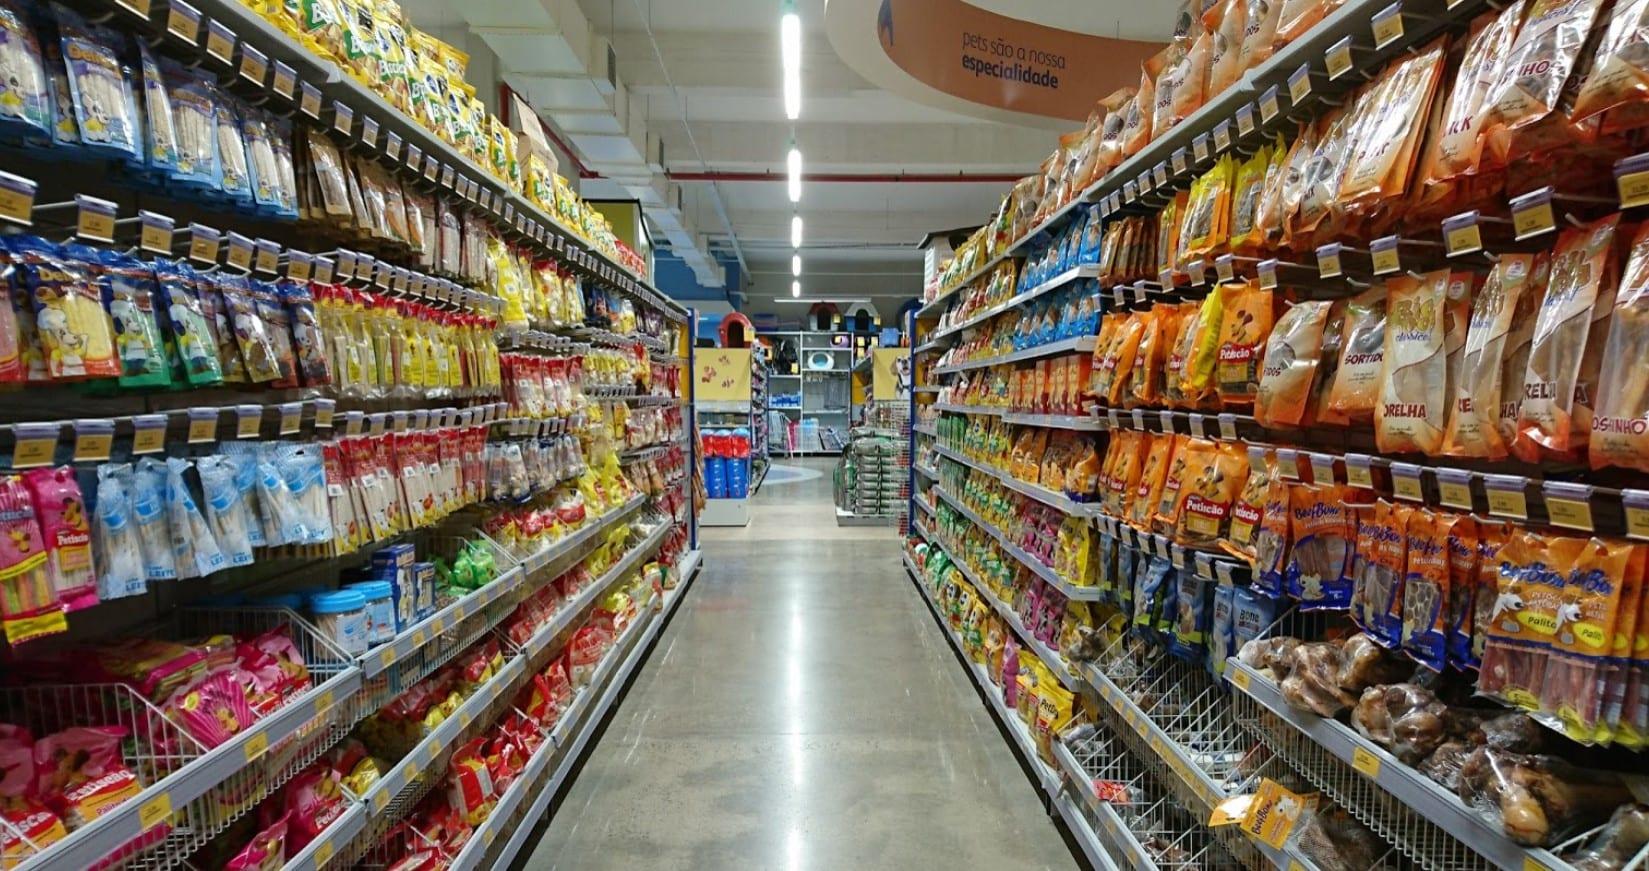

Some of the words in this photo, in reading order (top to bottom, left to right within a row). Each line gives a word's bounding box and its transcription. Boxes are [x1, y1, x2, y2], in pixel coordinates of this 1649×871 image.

[962, 31, 987, 51] pets
[990, 38, 1014, 58] são
[1017, 47, 1026, 60] a
[1029, 49, 1066, 69] nossa
[962, 54, 1059, 88] especialidade
[1186, 499, 1225, 516] Petiscão
